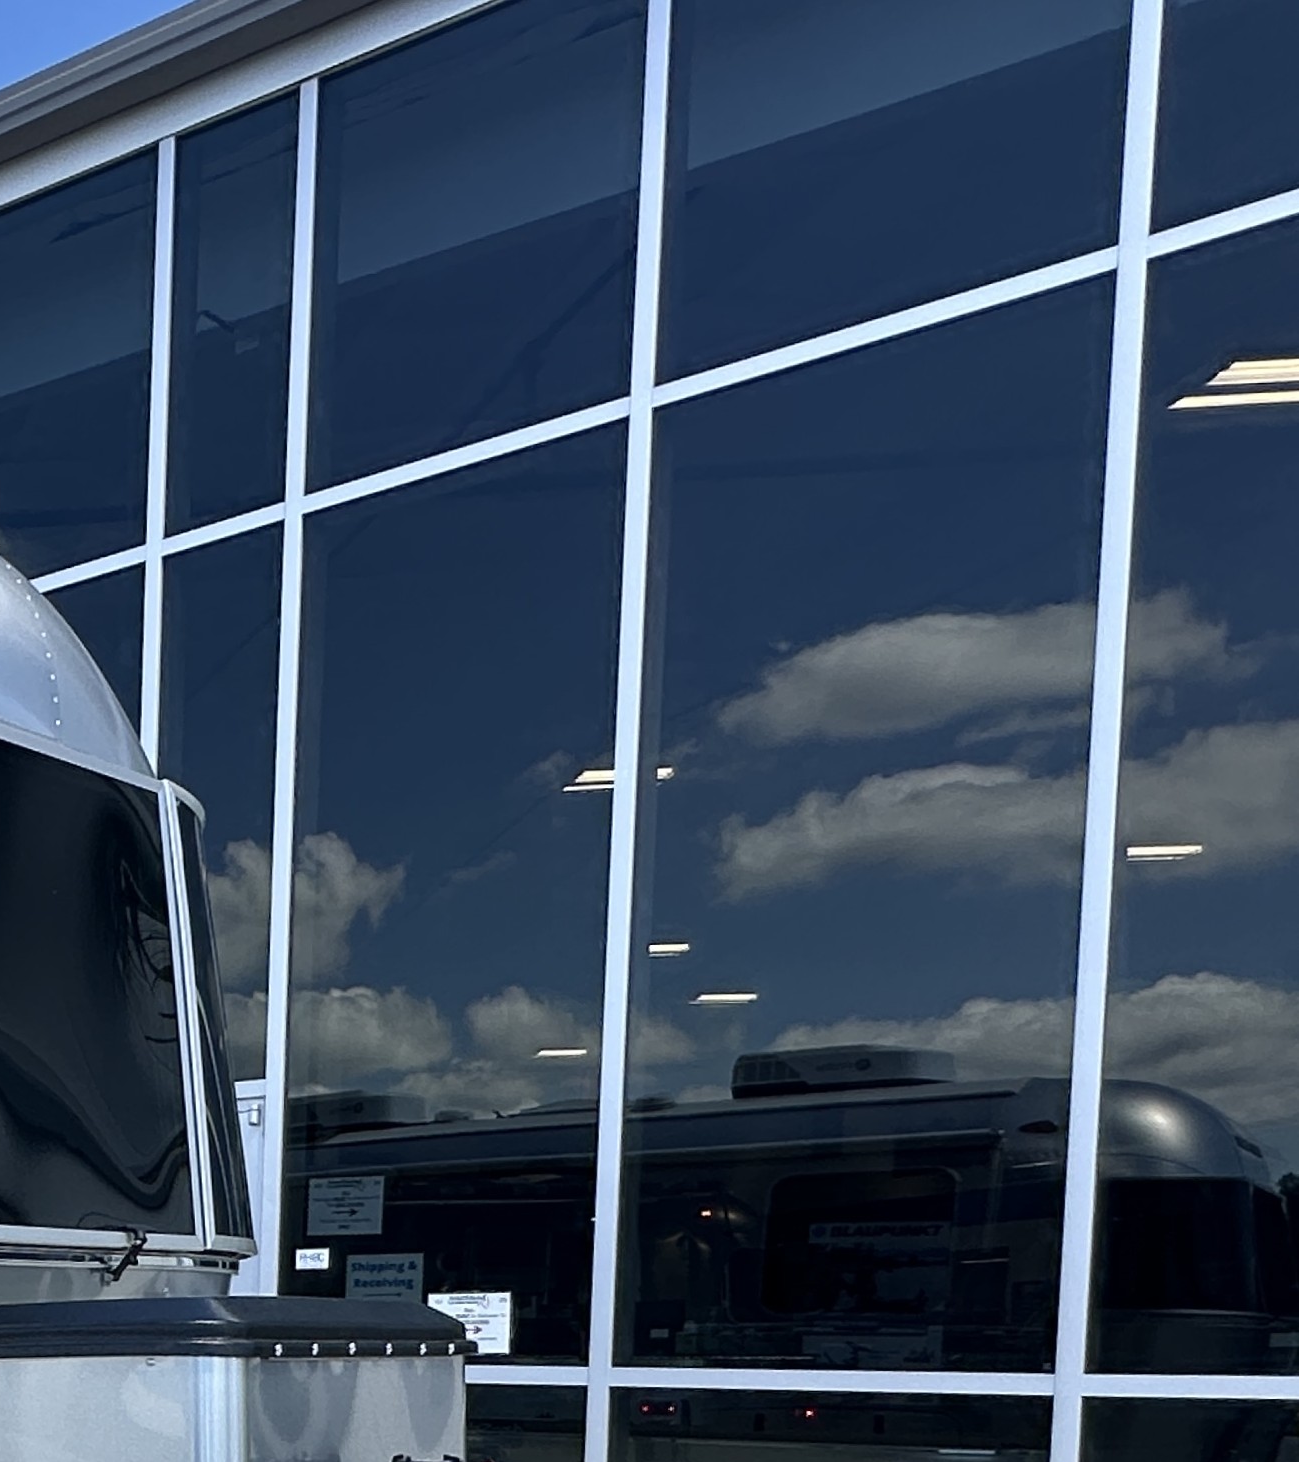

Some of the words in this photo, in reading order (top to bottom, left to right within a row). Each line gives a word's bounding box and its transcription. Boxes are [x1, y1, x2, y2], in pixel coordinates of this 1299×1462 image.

[830, 1224, 944, 1238] BLAUPUNKT
[351, 1260, 405, 1275] Shipping
[408, 1260, 417, 1271] &
[353, 1277, 414, 1290] Receiving
